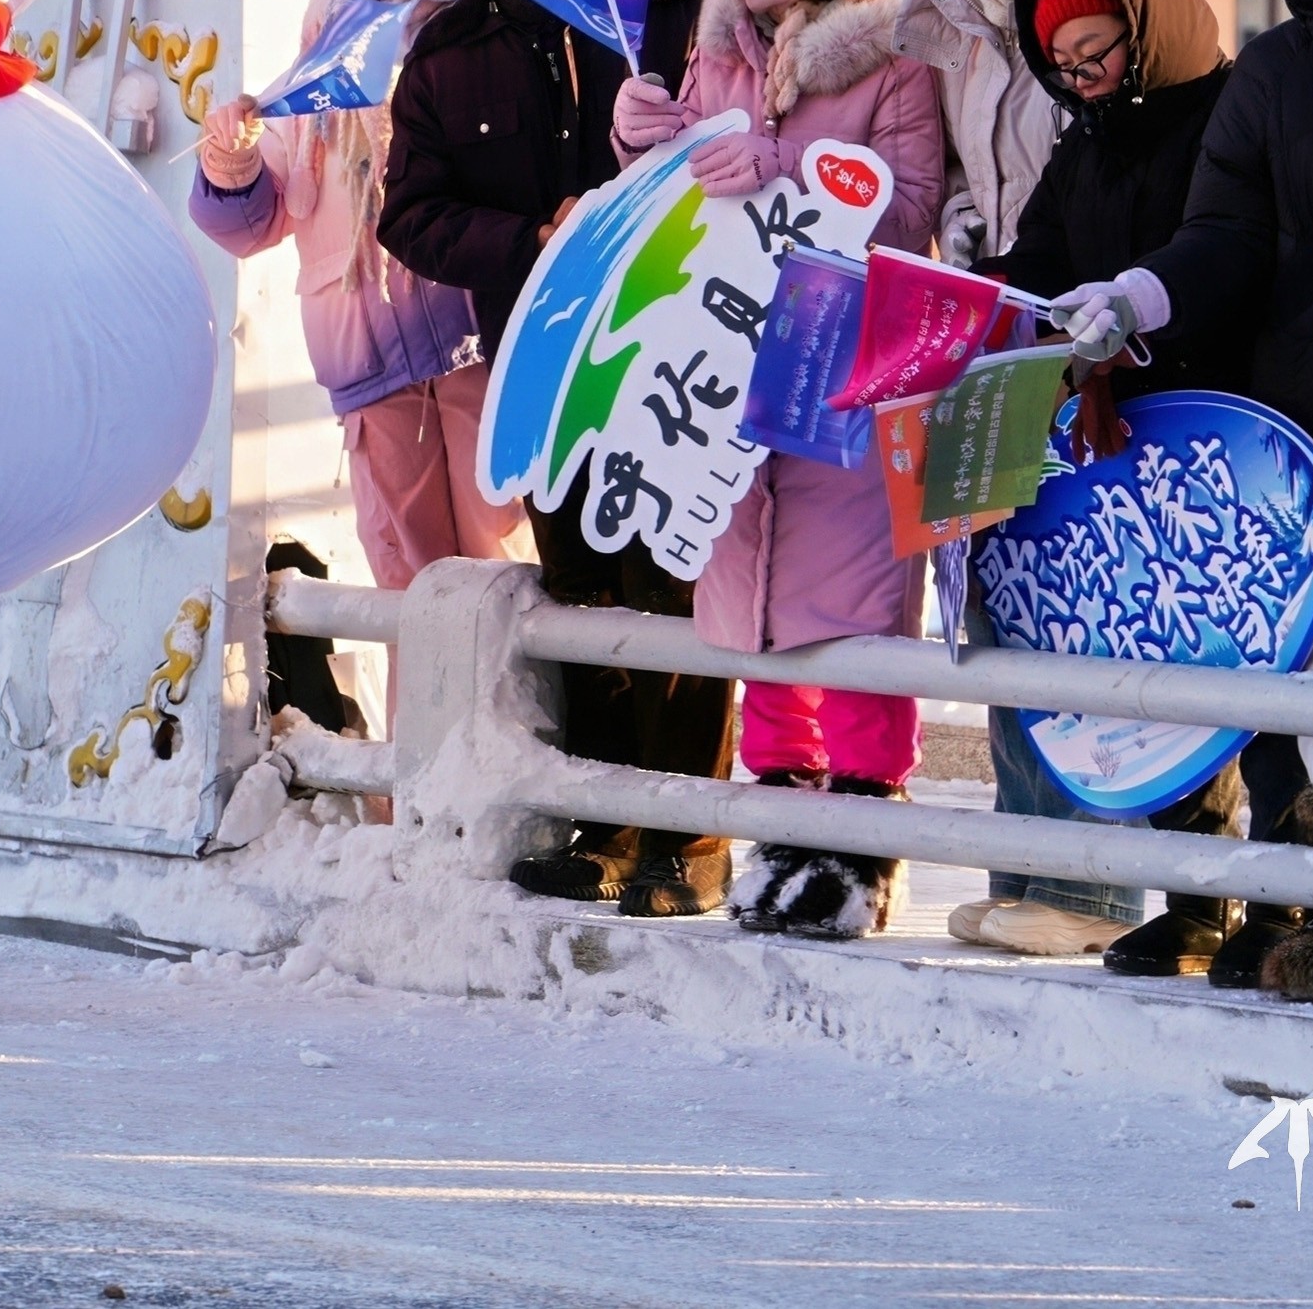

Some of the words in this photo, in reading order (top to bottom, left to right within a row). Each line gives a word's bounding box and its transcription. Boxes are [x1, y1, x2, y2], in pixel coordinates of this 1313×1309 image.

[987, 438, 1237, 641] 歌游内蒙古
